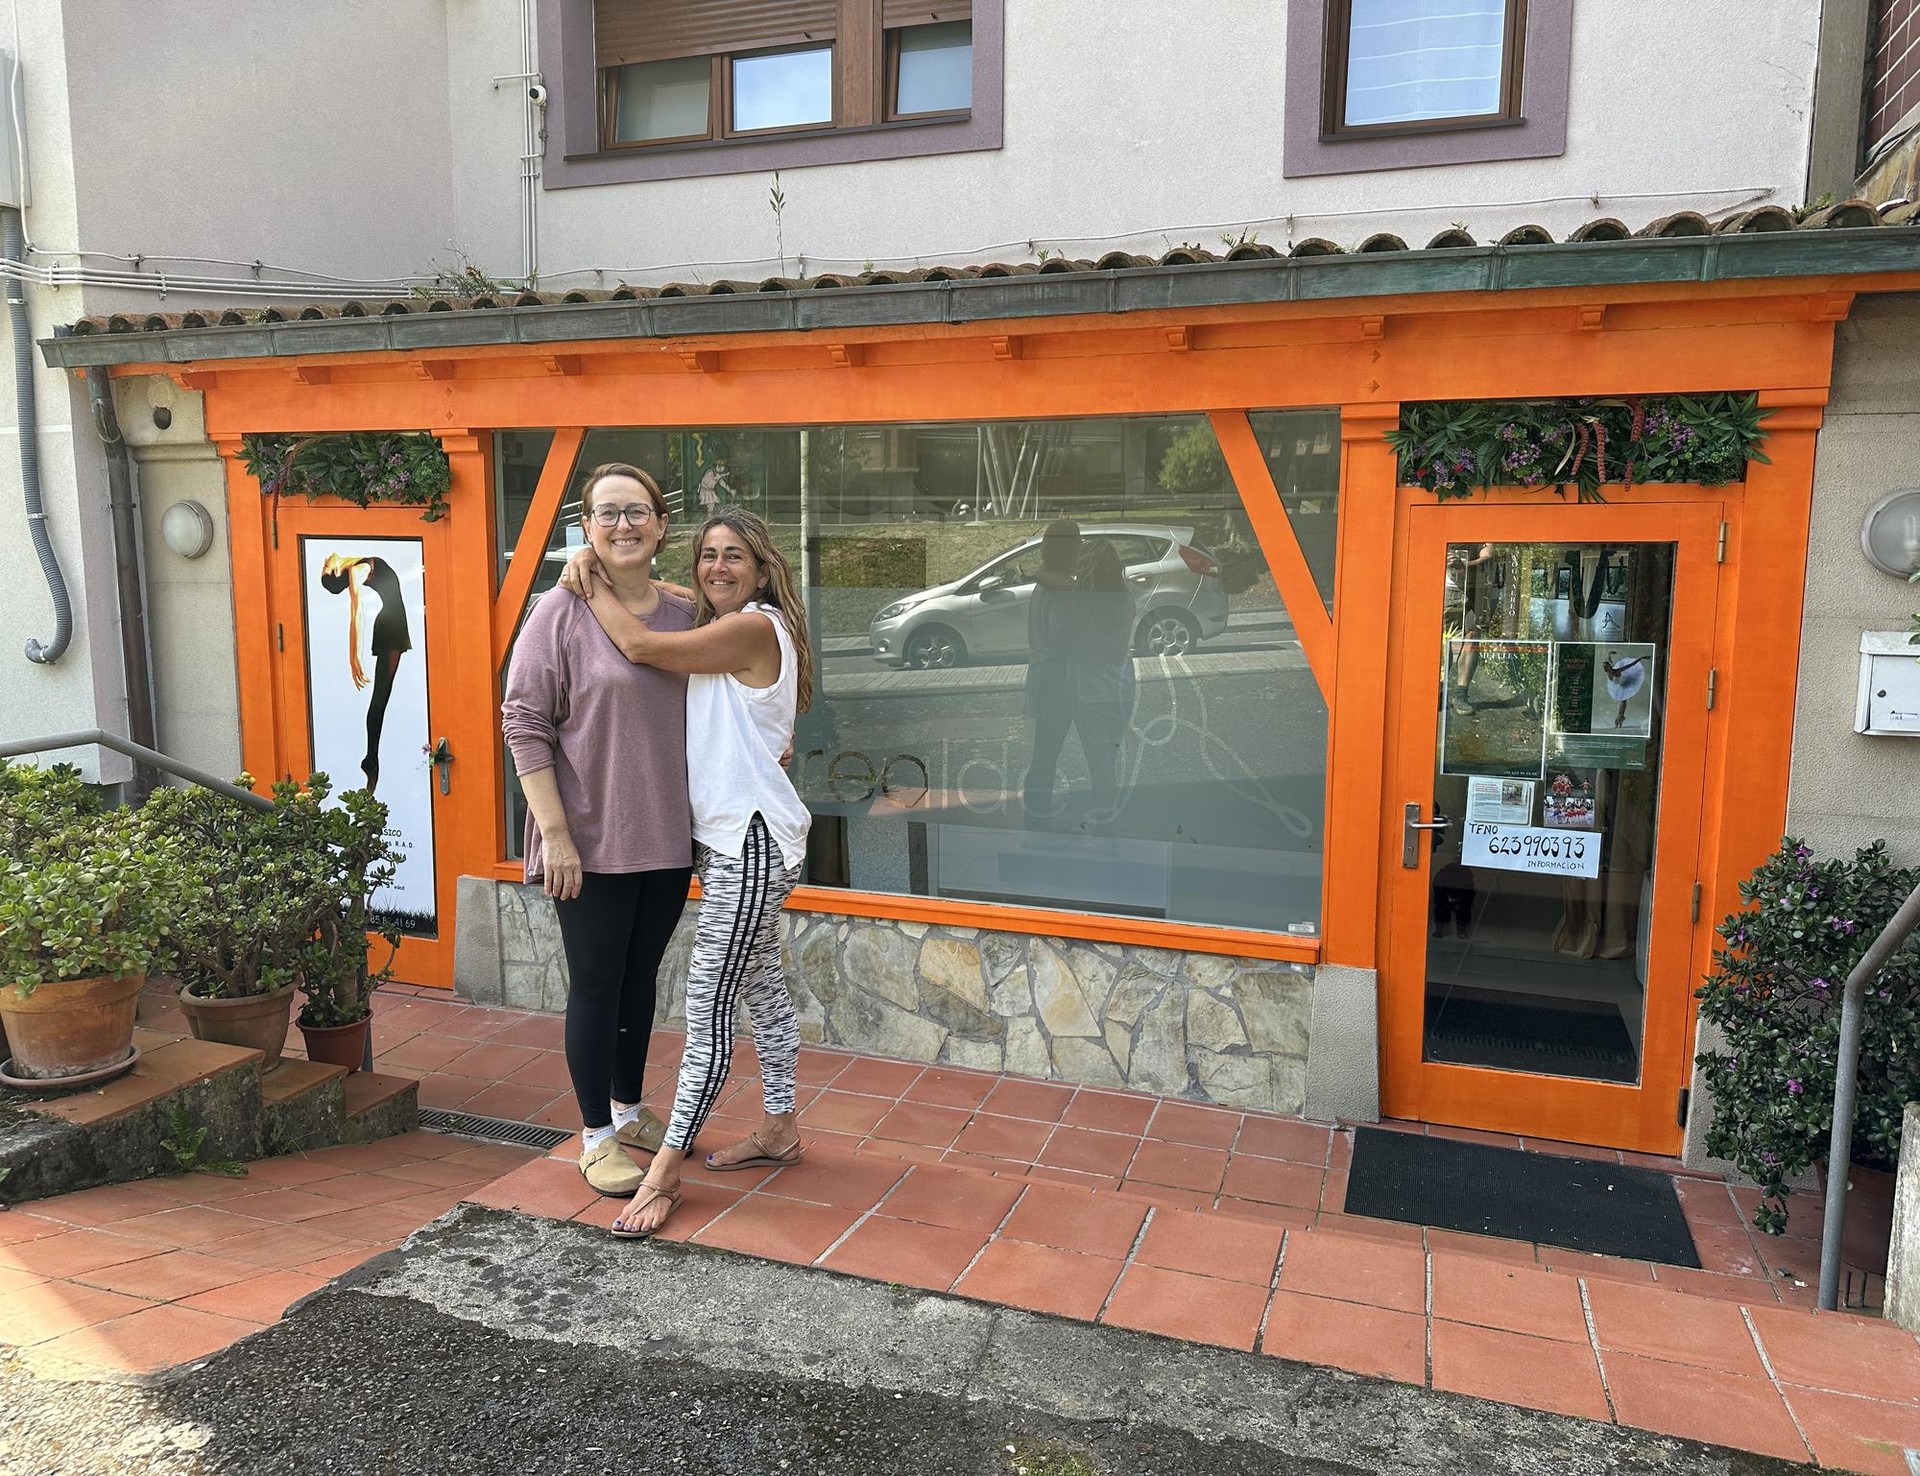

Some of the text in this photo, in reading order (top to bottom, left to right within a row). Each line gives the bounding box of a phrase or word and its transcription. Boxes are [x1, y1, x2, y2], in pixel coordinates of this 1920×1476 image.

[383, 829, 402, 838] SICO
[1468, 822, 1499, 835] TFNO
[1489, 835, 1585, 859] 623990393
[405, 919, 416, 929] 69
